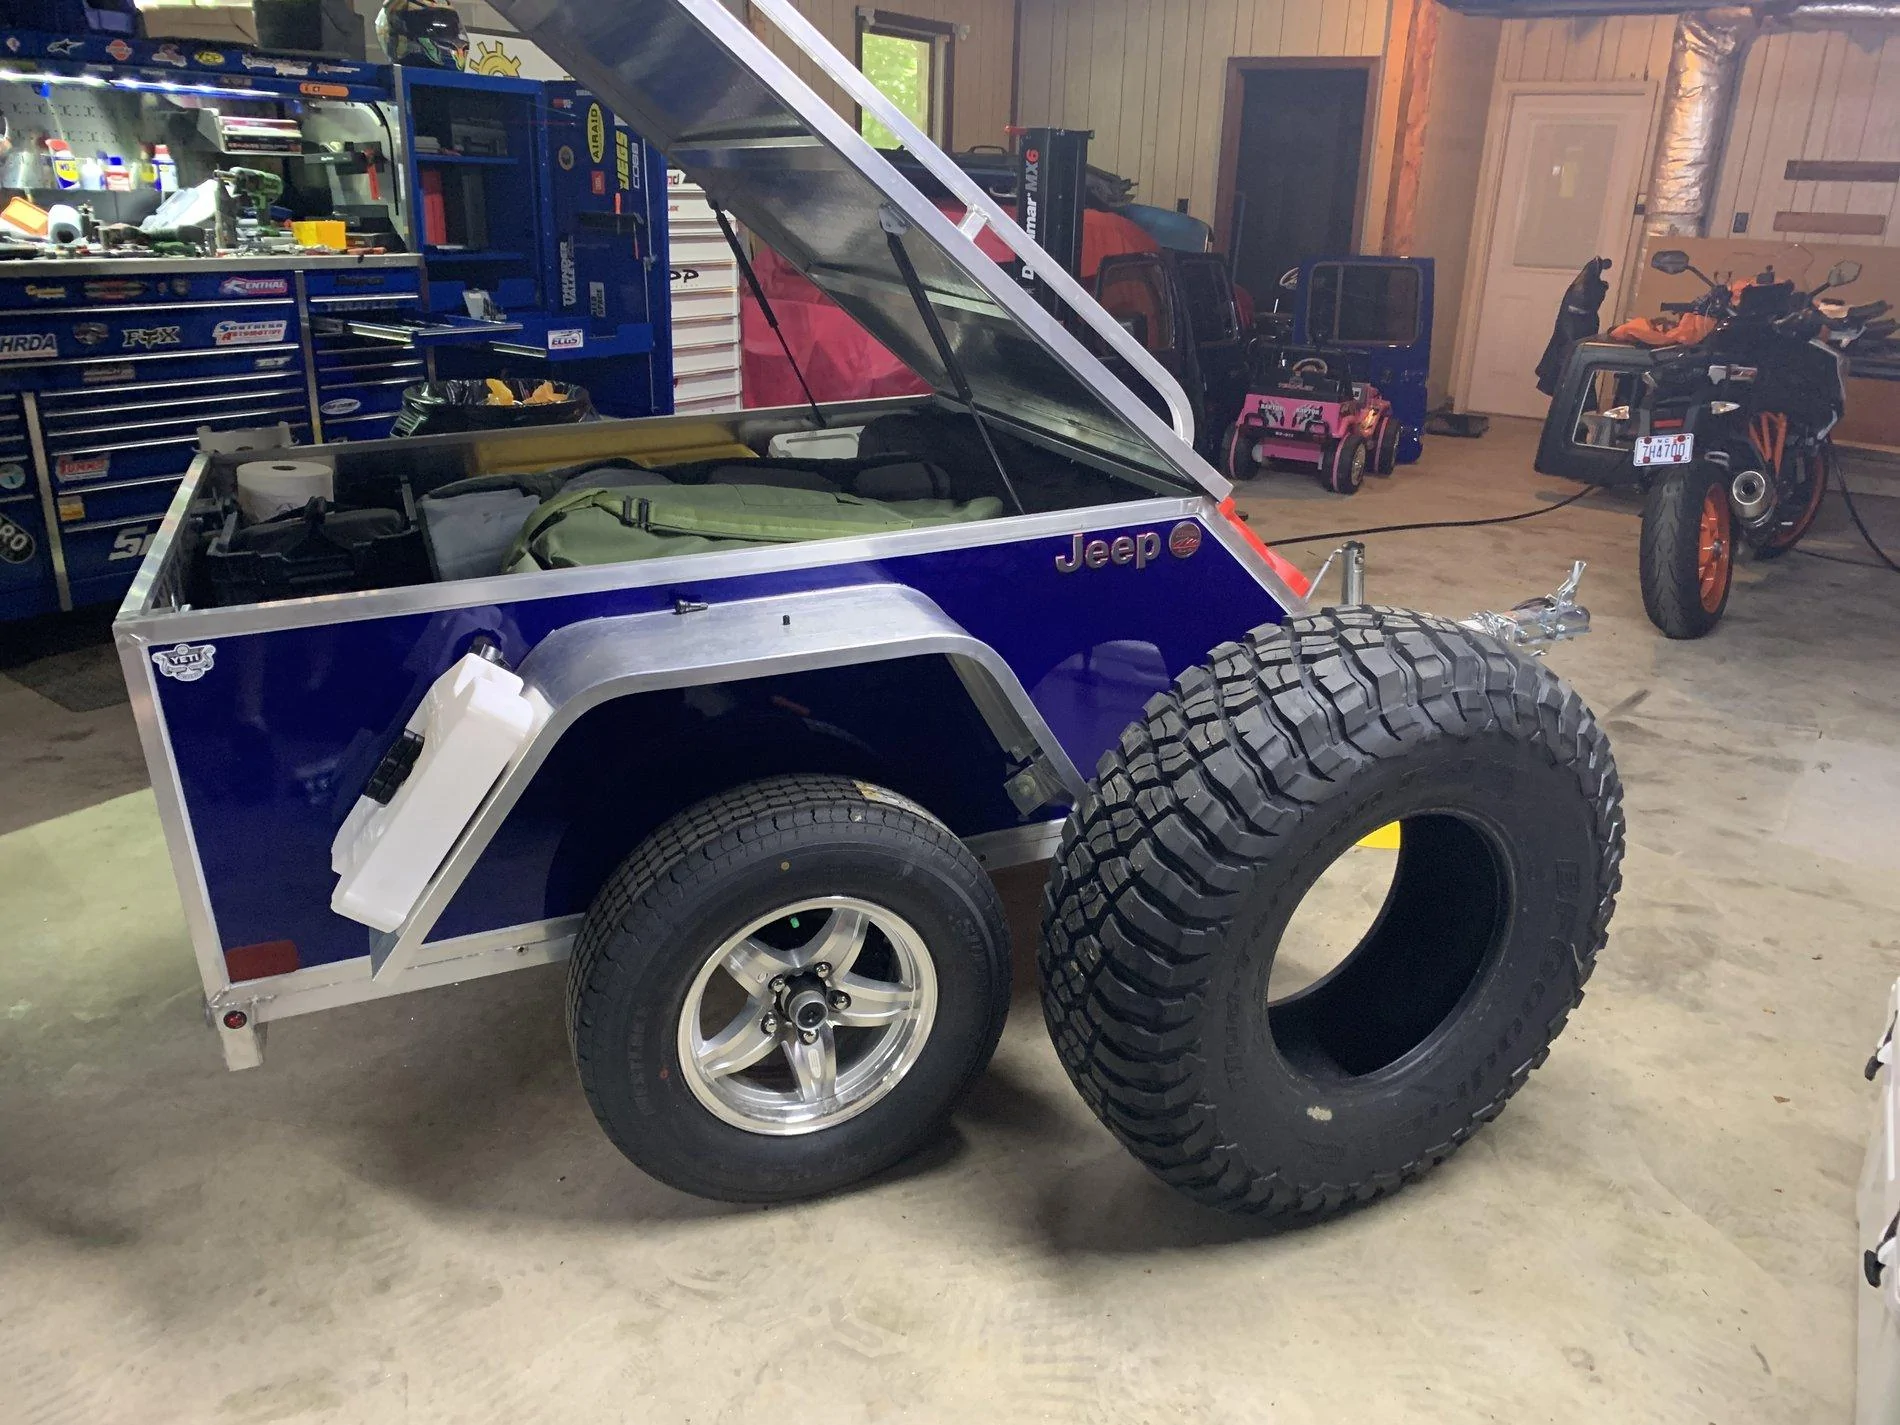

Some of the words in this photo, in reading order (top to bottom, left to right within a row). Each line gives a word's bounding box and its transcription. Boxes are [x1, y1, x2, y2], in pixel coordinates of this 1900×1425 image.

[590, 107, 600, 160] AIRAID
[616, 130, 630, 191] JEGS
[631, 142, 640, 190] COBB
[1021, 196, 1037, 280] Dmar
[122, 326, 180, 348] FOX
[1055, 532, 1161, 573] Jeep
[170, 653, 200, 665] YETI
